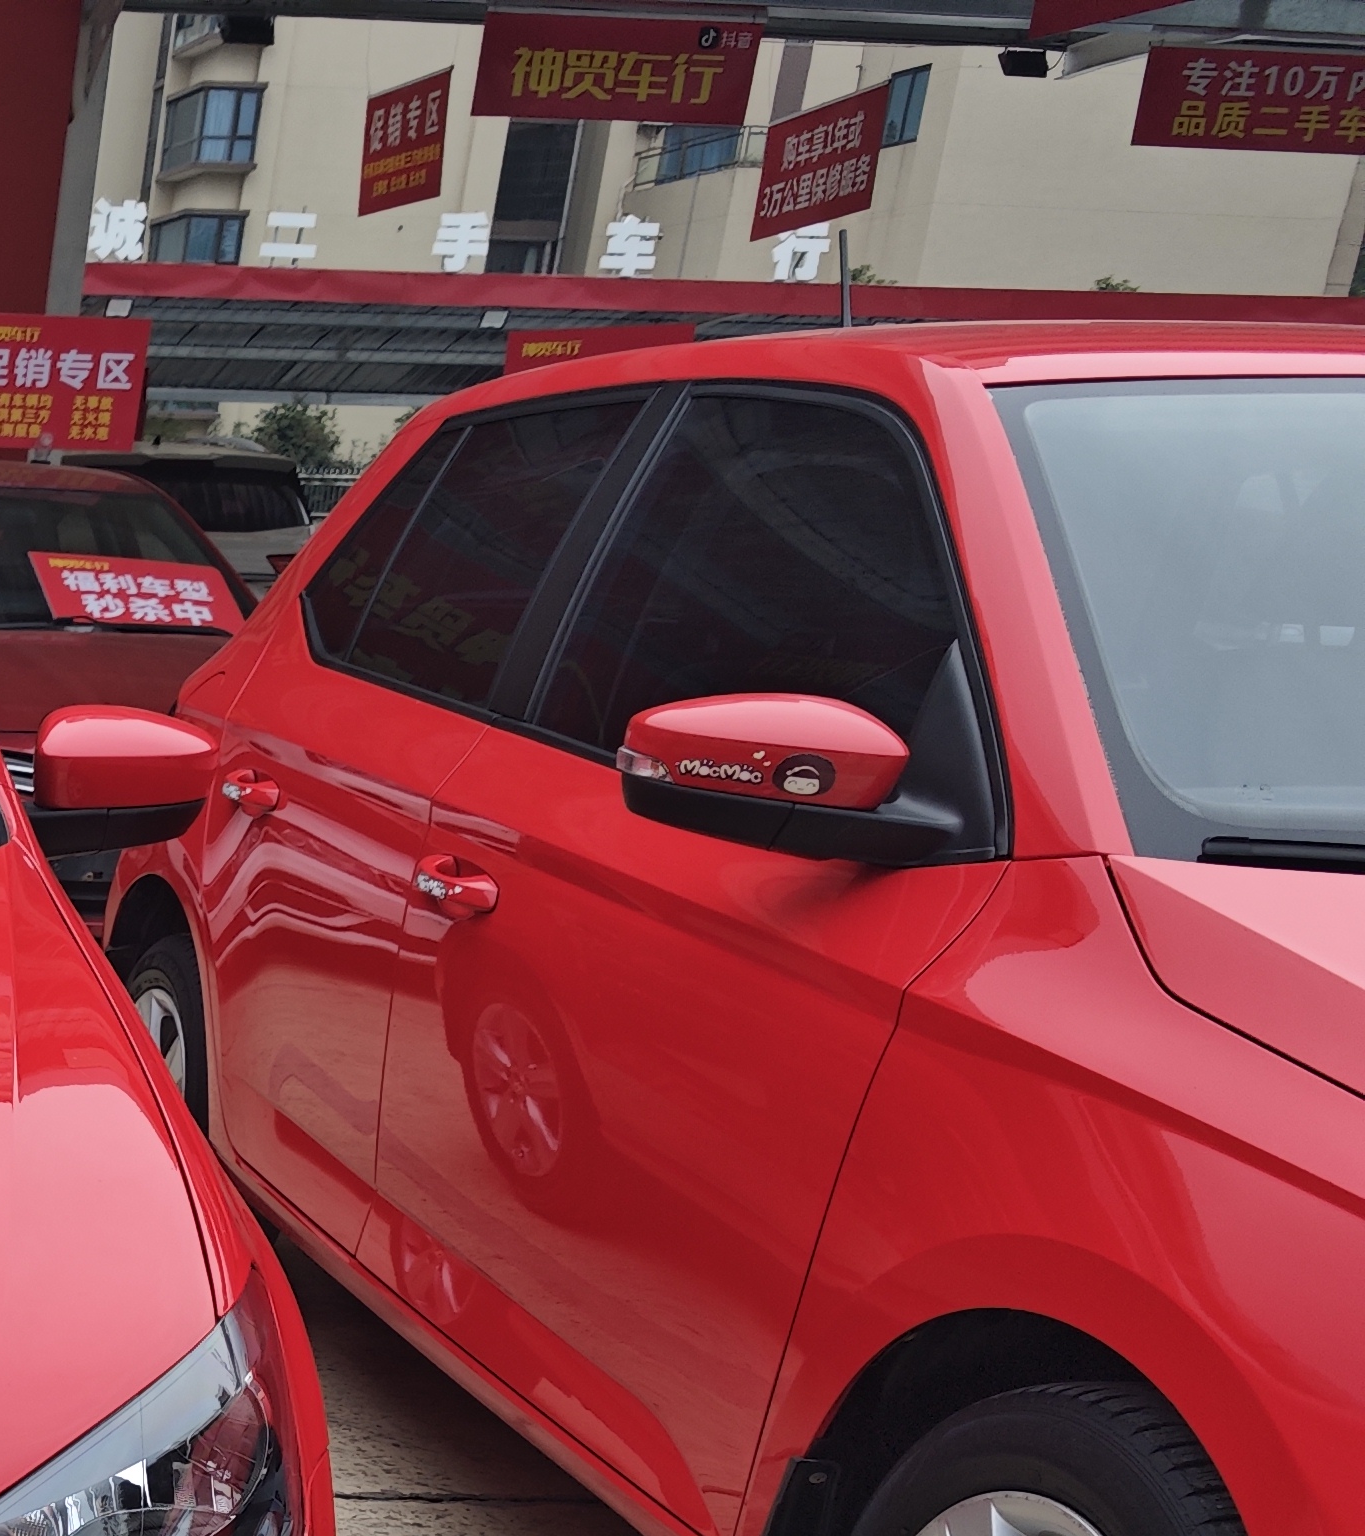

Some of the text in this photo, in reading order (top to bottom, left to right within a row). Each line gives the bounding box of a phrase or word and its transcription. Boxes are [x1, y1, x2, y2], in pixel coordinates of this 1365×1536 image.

[511, 47, 725, 104] 神贸车行
[369, 89, 441, 155] 促销专区
[781, 110, 865, 172] 购车享1年或
[1172, 100, 1365, 143] 品质二手车
[759, 153, 871, 218] 3万公里保修服务
[61, 569, 214, 602] 福利车型
[80, 593, 213, 626] 秒杀中
